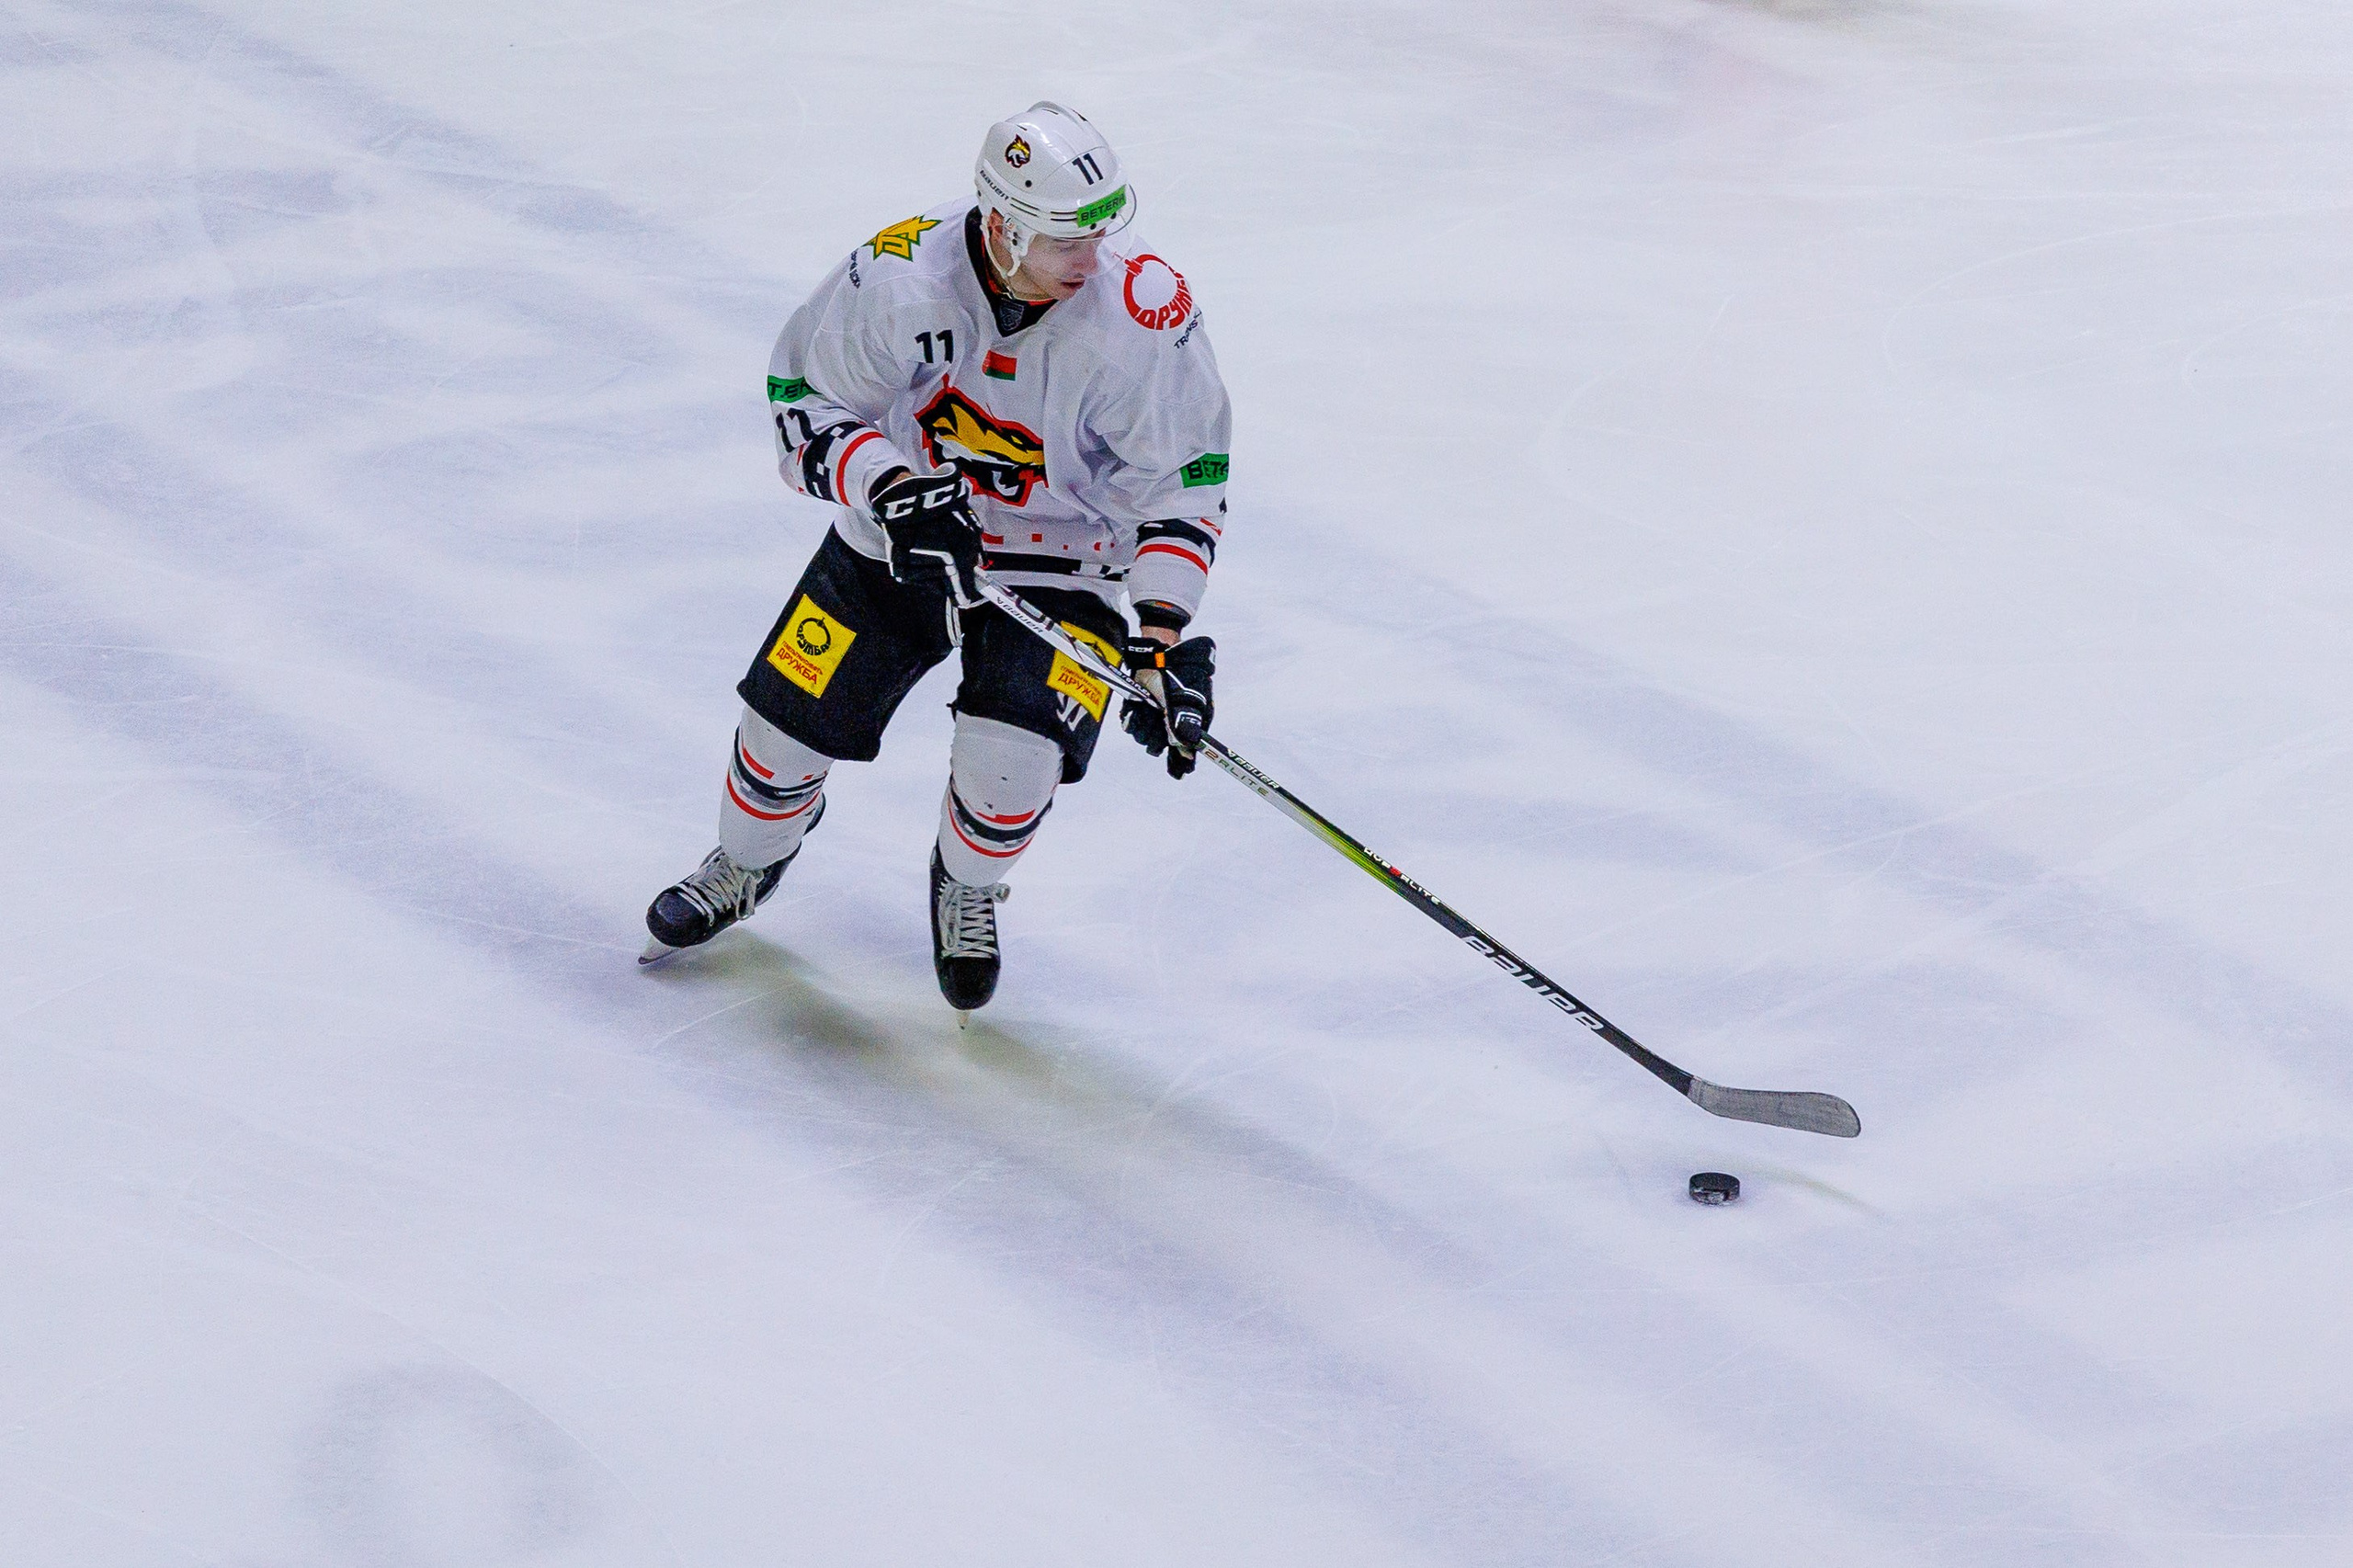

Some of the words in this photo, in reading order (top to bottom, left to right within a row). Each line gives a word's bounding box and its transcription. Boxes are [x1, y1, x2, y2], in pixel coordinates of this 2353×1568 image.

[1072, 153, 1104, 185] 11
[914, 329, 954, 364] 11
[776, 407, 816, 453] 11
[776, 647, 817, 685] ДРУЖБА
[1461, 935, 1604, 1031] BAUER
